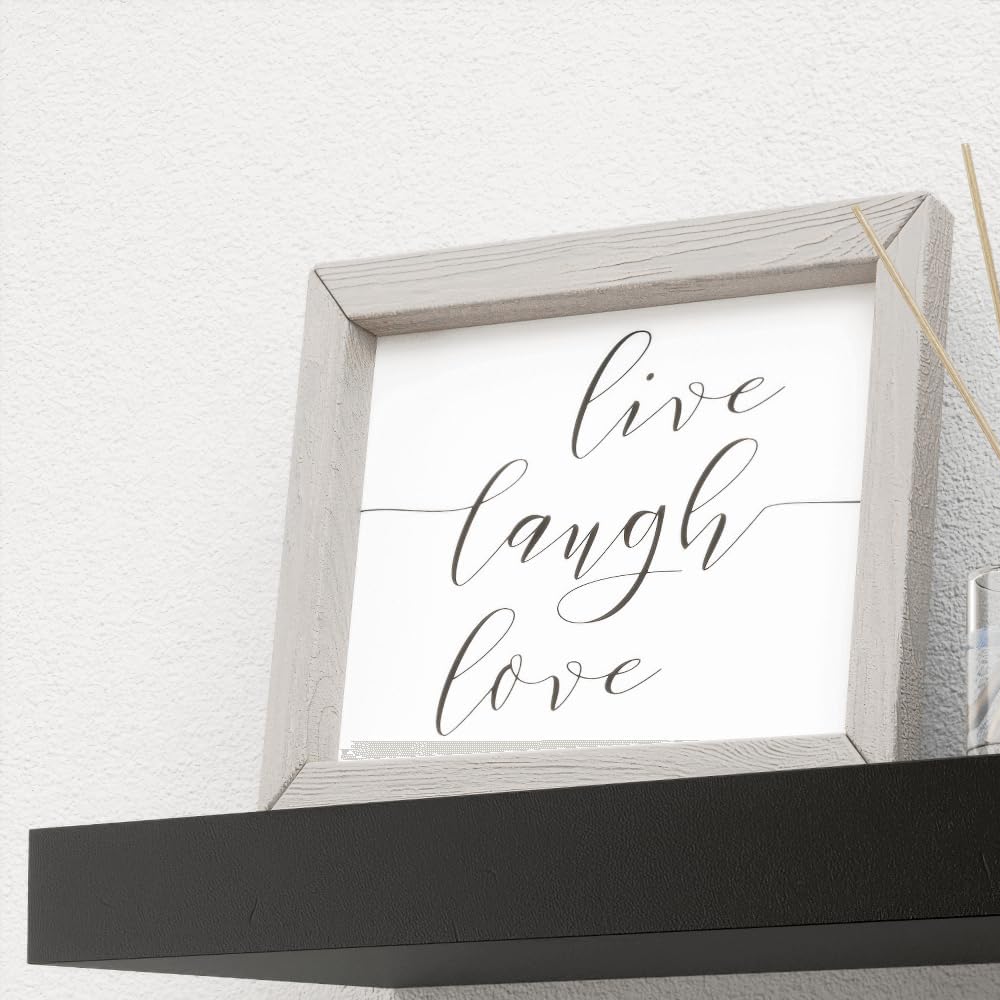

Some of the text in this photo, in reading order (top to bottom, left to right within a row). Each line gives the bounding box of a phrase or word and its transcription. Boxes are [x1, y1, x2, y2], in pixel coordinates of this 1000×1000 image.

[571, 330, 786, 460] live
[450, 437, 768, 624] laugh
[435, 607, 662, 737] love
